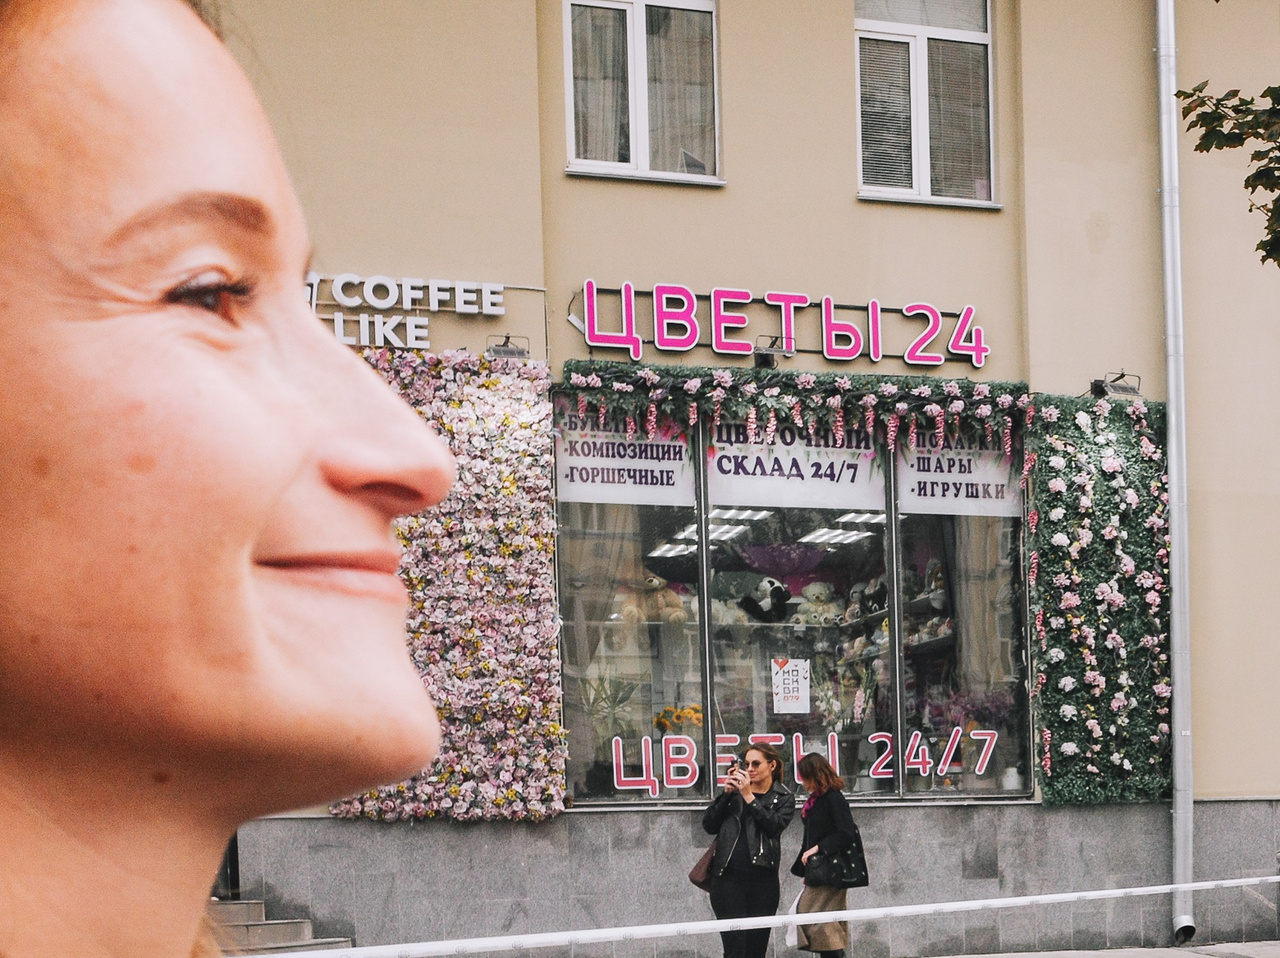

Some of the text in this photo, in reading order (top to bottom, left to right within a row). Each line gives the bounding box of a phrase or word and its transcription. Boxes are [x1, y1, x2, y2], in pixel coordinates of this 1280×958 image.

[332, 273, 506, 315] COFFEE
[334, 312, 430, 349] LIKE
[583, 278, 991, 369] ЦВЕТЫ 24
[717, 454, 859, 484] СКЛАД 24/7
[867, 726, 999, 779] 24/7
